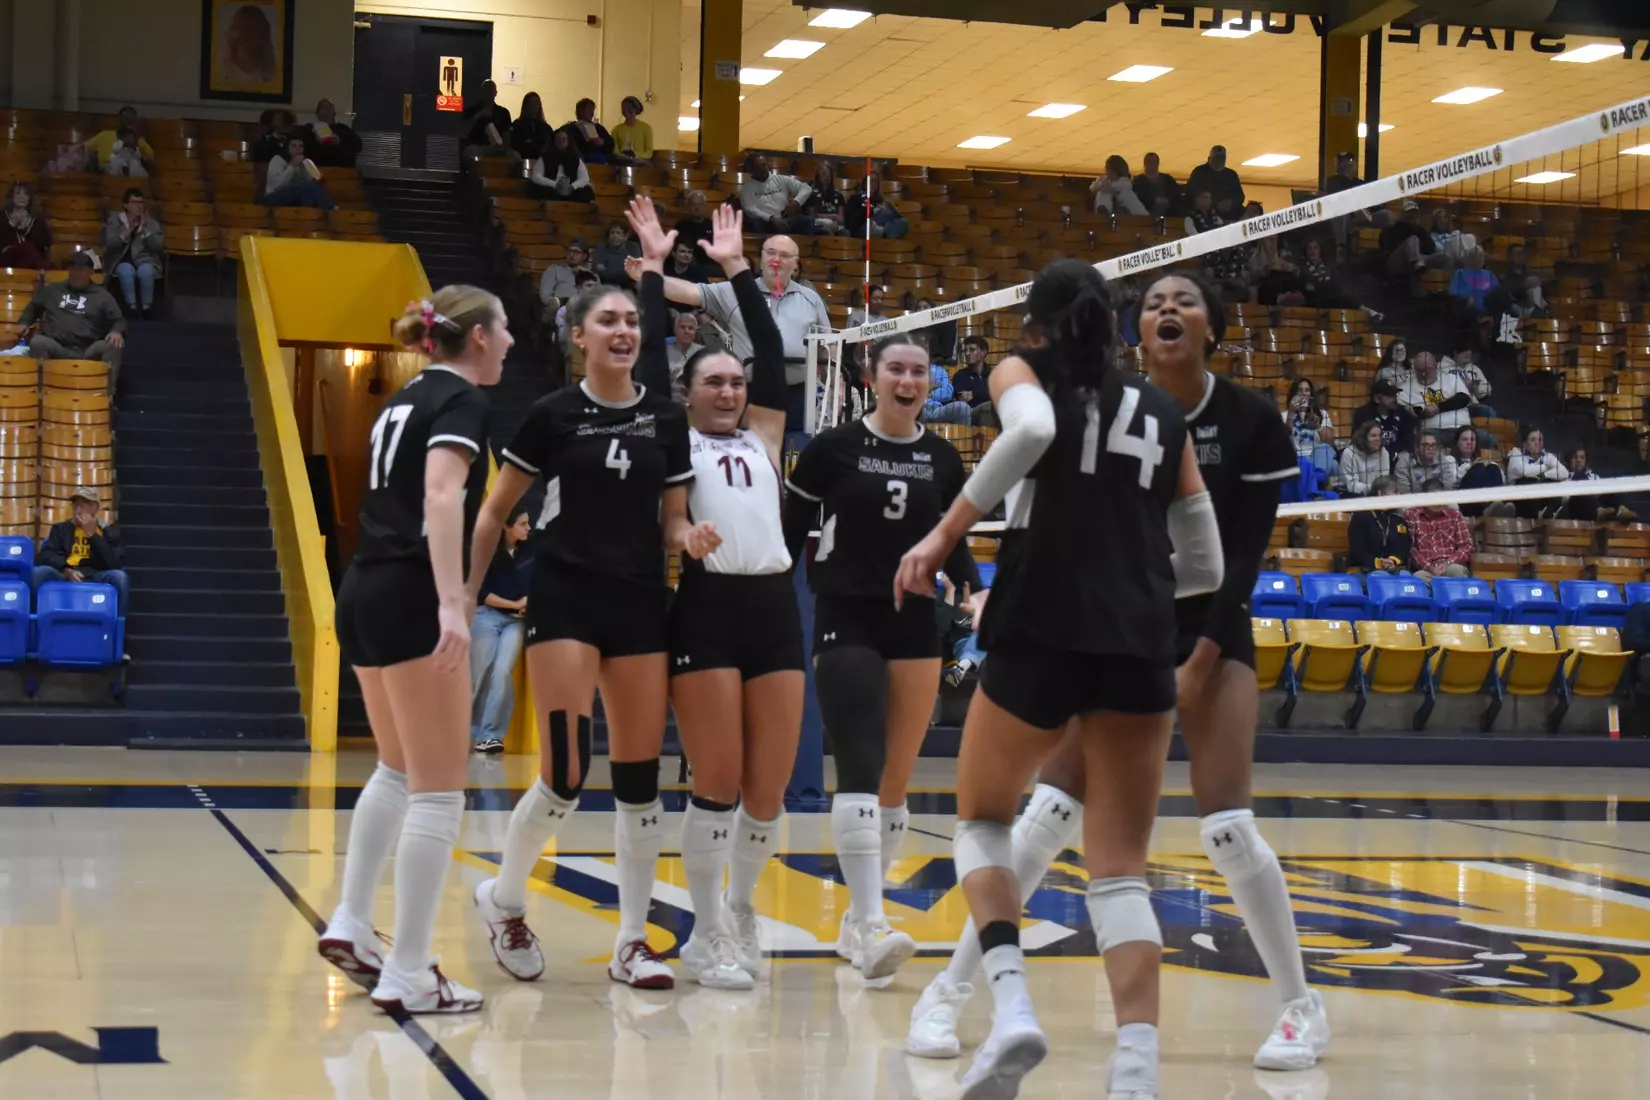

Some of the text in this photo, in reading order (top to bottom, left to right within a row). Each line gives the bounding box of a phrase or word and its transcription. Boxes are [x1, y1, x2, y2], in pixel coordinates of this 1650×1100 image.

[1610, 102, 1648, 128] RACER
[1407, 151, 1492, 189] RACER VOLLEYBALL
[1248, 204, 1316, 235] RACER VOLLEYBALL
[370, 404, 415, 490] 17
[1080, 386, 1165, 490] 14
[606, 438, 632, 480] 4
[717, 455, 752, 487] 11
[858, 456, 934, 481] SALUKIS
[883, 480, 908, 519] 3
